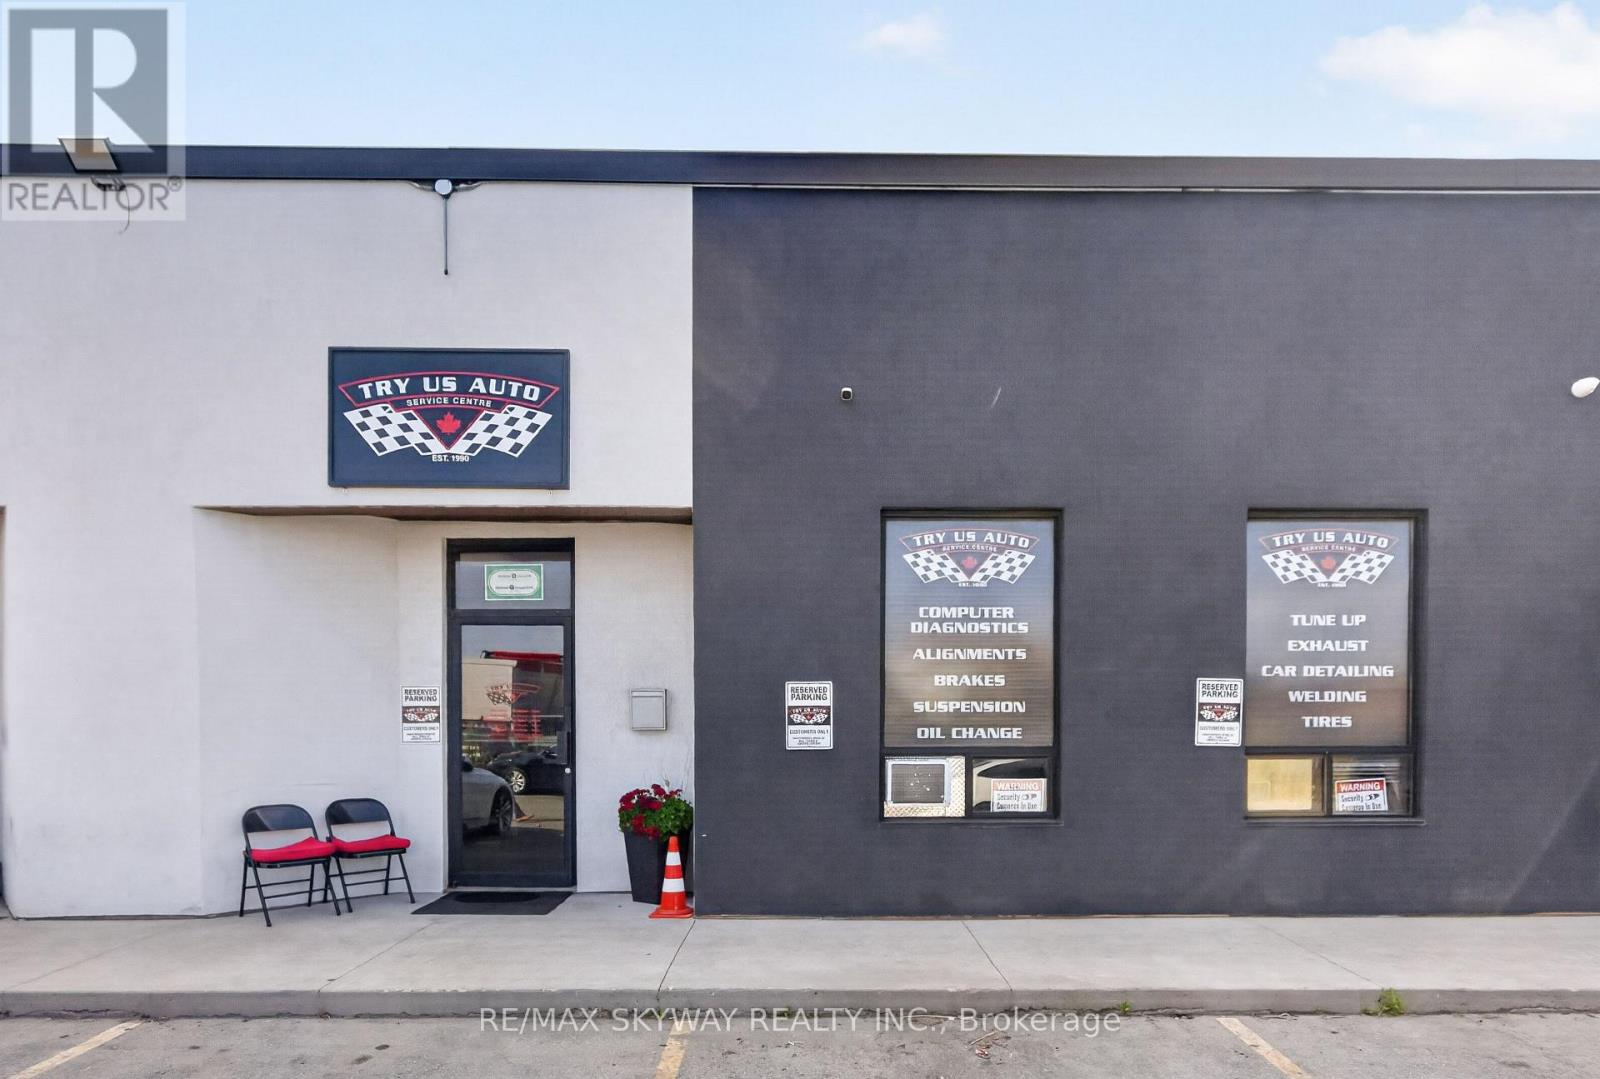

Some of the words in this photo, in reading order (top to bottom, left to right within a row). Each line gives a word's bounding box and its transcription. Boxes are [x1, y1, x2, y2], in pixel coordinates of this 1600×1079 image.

[358, 376, 410, 400] TRY
[423, 376, 457, 392] US
[469, 378, 541, 402] AUTO
[406, 396, 449, 407] SERVICE
[453, 396, 492, 408] CENTRE
[912, 532, 946, 547] TRY
[954, 531, 976, 542] US
[983, 532, 1030, 548] AUTO
[1272, 532, 1306, 547] TRY
[1313, 532, 1336, 542] US
[1342, 532, 1389, 548] AUTO
[918, 606, 1014, 619] COMPUTER
[1290, 614, 1336, 626] TUNE
[1342, 614, 1367, 626] UP
[910, 621, 1029, 634] DIAGNOSTICS
[1288, 640, 1369, 652] EXHAUST
[913, 648, 1027, 660] ALIGNMENTS
[1261, 665, 1297, 677] CAR
[1302, 665, 1394, 677] DETAILING
[934, 674, 1006, 687] BRAKES
[1288, 691, 1367, 702] WELDING
[913, 701, 1026, 713] SUSPENSION
[1301, 716, 1352, 728] TIRES
[916, 727, 946, 739] OIL
[951, 727, 1023, 739] CHANGE
[996, 781, 1040, 791] WARNING
[1340, 782, 1381, 792] WARNING
